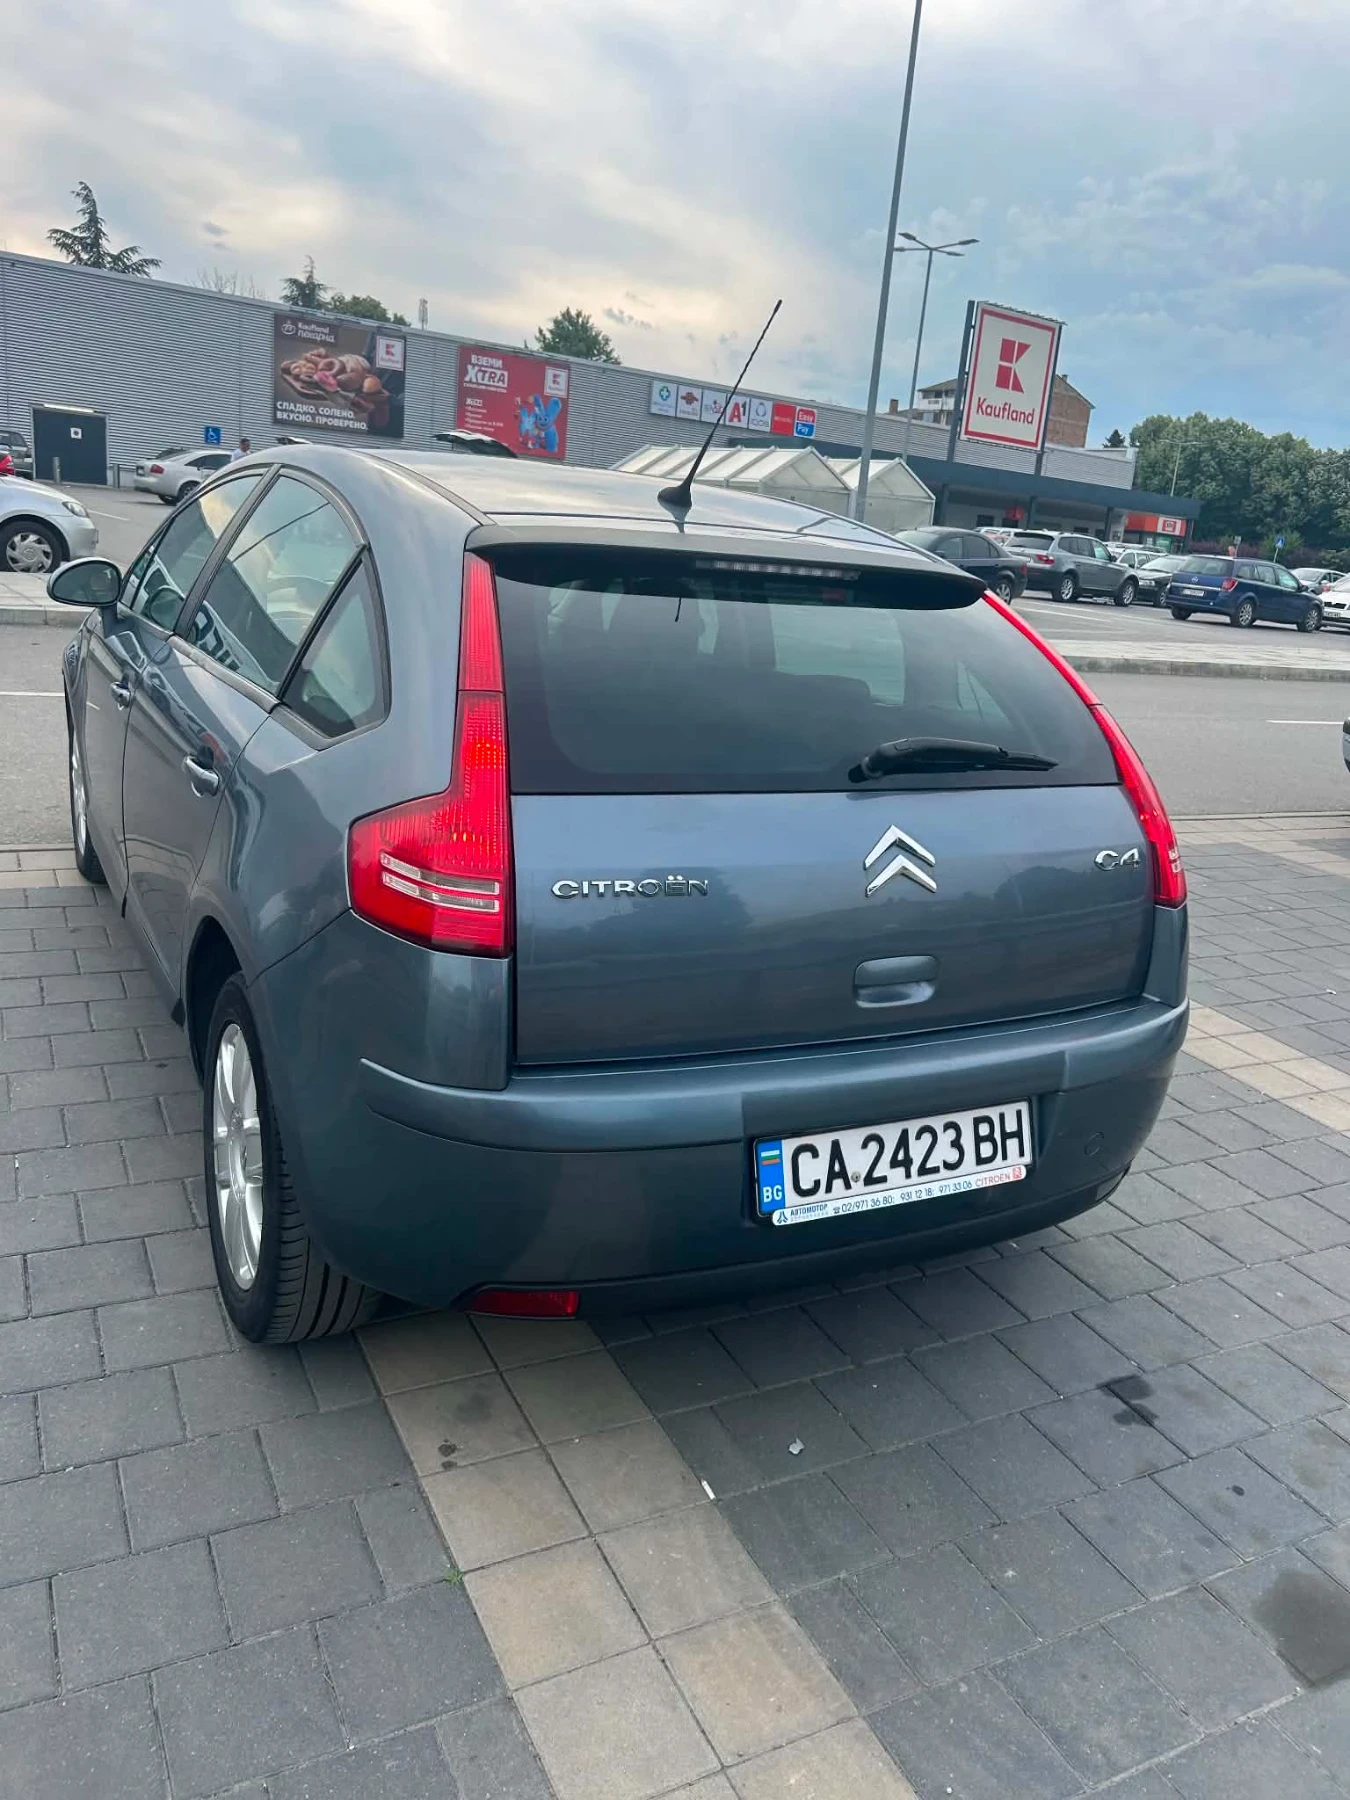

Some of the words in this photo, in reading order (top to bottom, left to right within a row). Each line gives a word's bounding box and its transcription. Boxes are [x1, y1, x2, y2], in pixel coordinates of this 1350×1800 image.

[471, 355, 502, 368] ВЗЕМИ
[276, 401, 317, 414] СЛАДКО.
[319, 407, 356, 419] СОЛЕНО.
[728, 401, 747, 422] A1
[798, 411, 814, 423] Easy
[976, 397, 1035, 424] Kaufland
[276, 411, 314, 423] ВКУСНО.
[315, 416, 368, 430] ПРОВЕРЕНО.
[1094, 848, 1140, 871] C4
[551, 875, 709, 898] CITROËN
[975, 1173, 1011, 1187] CITROEN
[763, 1185, 782, 1202] BG
[841, 1199, 869, 1213] 02/971
[871, 1198, 881, 1207] 36
[900, 1191, 912, 1201] 931
[915, 1189, 923, 1199] 12
[939, 1184, 951, 1194] 971
[953, 1182, 962, 1192] 33
[962, 1180, 973, 1190] 06
